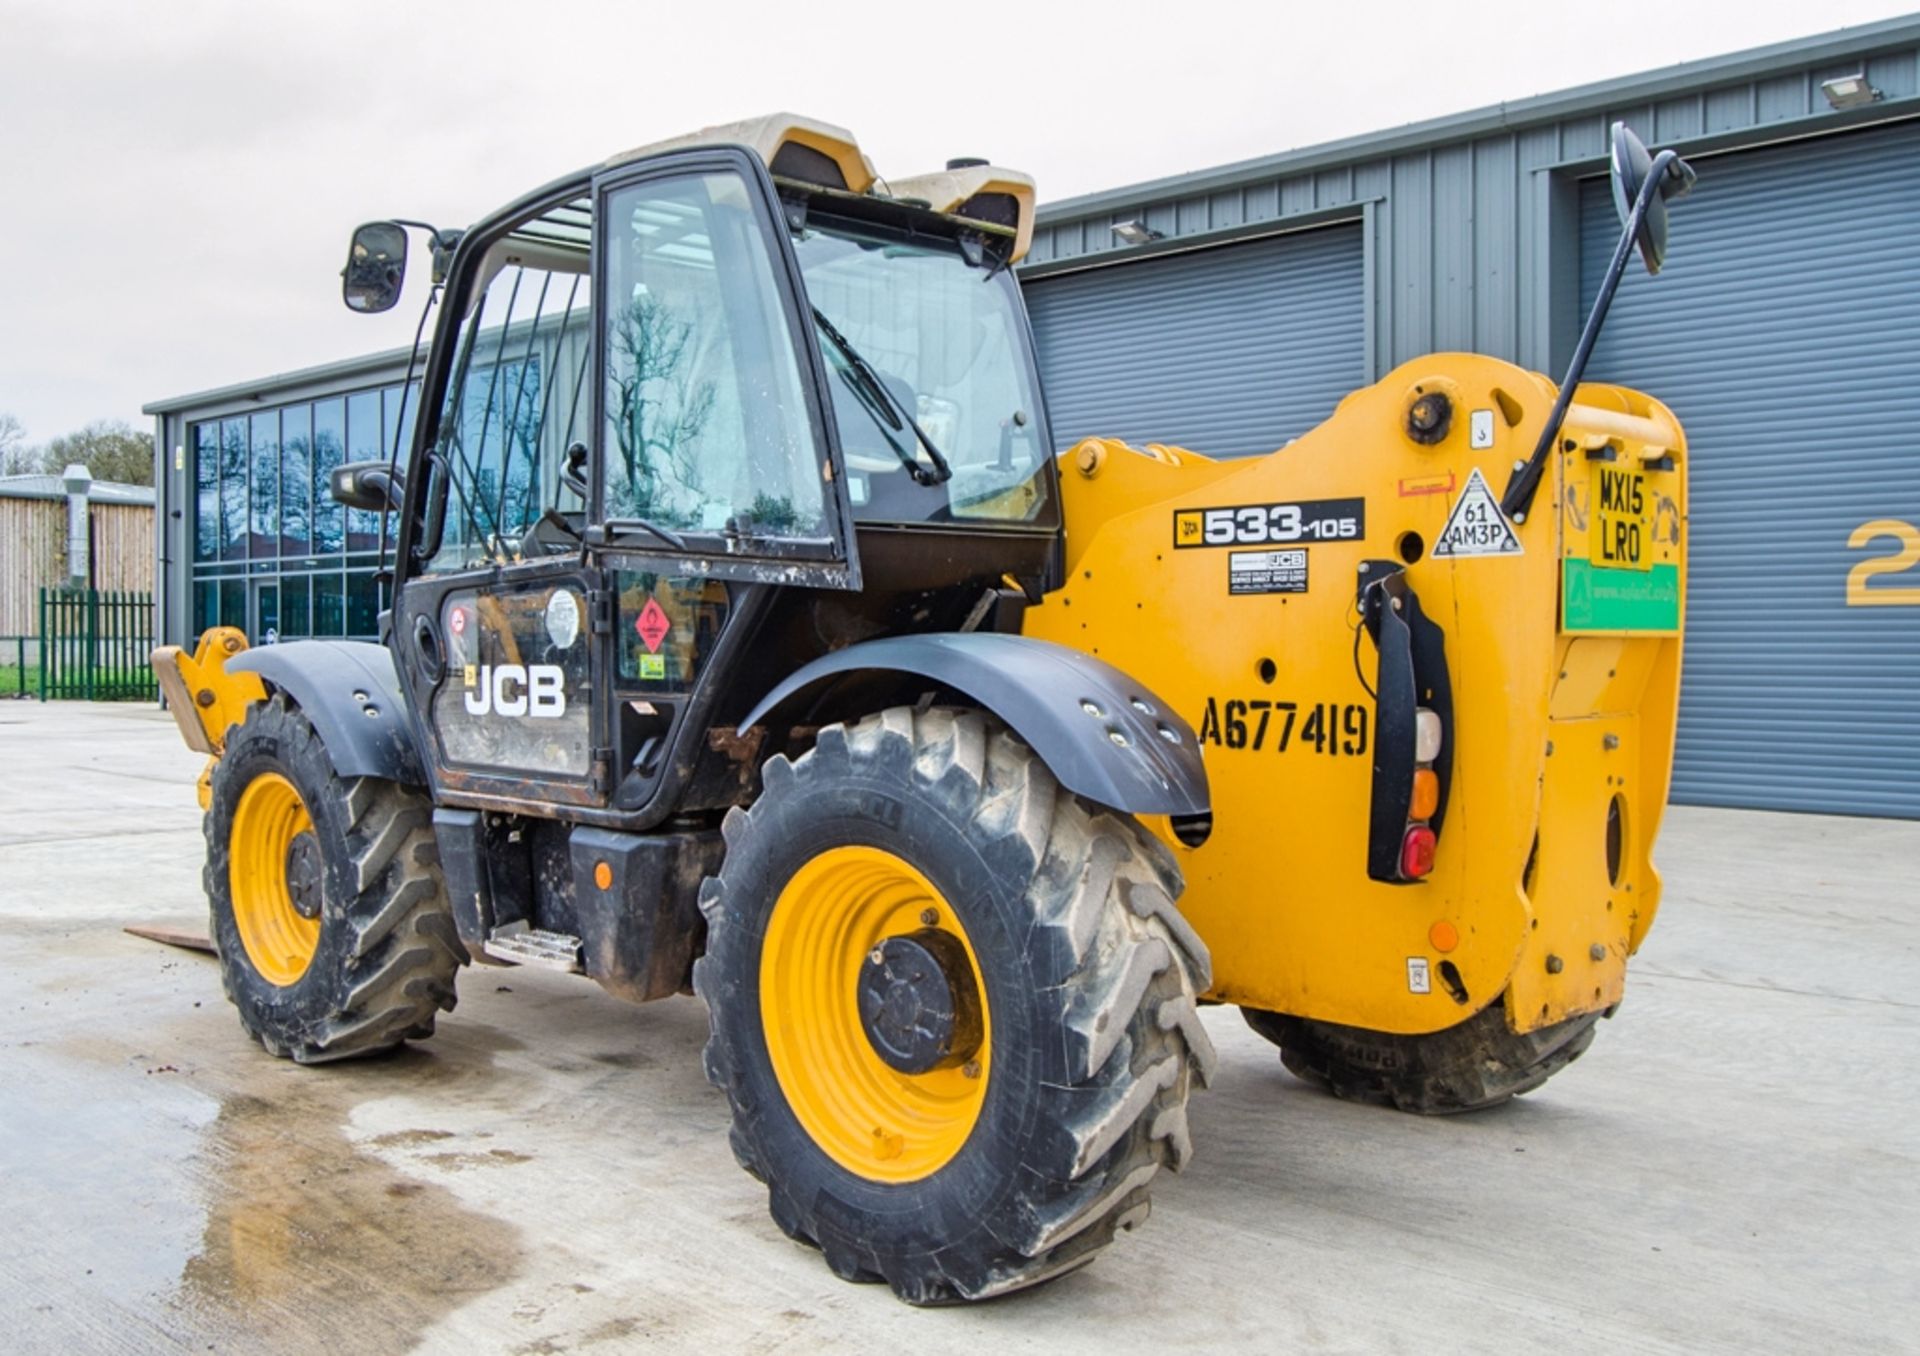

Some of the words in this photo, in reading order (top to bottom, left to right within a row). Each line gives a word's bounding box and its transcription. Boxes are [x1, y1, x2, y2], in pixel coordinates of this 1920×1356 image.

[1464, 503, 1487, 523] 61
[1600, 469, 1644, 514] MX15
[1453, 524, 1502, 545] AM3P
[1602, 519, 1641, 562] LRO
[1269, 552, 1304, 568] JCB
[1846, 518, 1920, 606] 2
[464, 664, 566, 718] JCB
[1199, 696, 1369, 756] A677419
